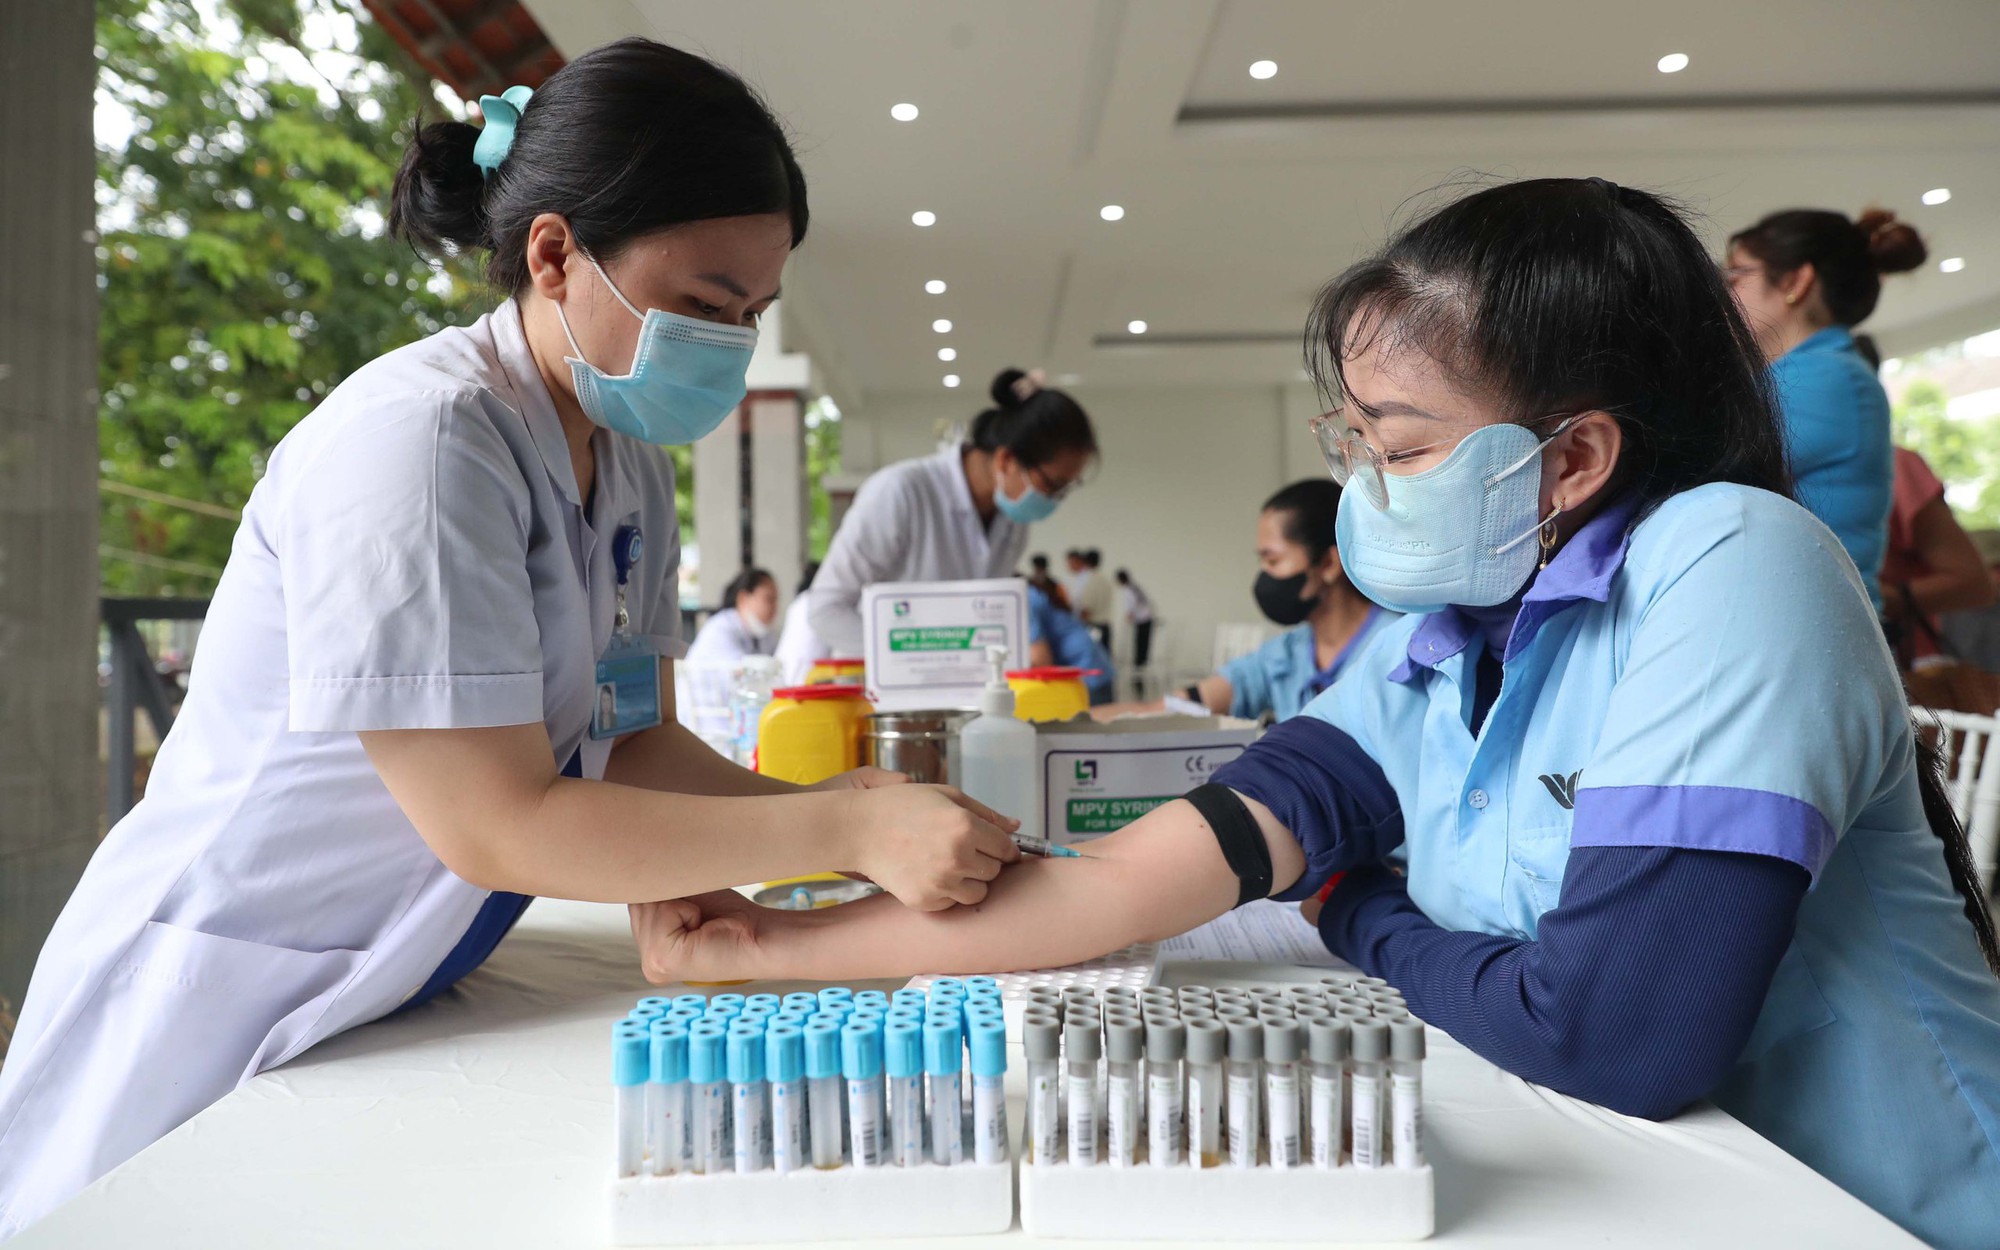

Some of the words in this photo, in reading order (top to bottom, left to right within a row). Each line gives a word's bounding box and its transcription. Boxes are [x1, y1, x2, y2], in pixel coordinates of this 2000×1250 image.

[920, 628, 969, 640] SYRINGE
[1072, 802, 1107, 816] MPV
[1111, 799, 1169, 815] SYRIN
[1085, 818, 1107, 829] FOR
